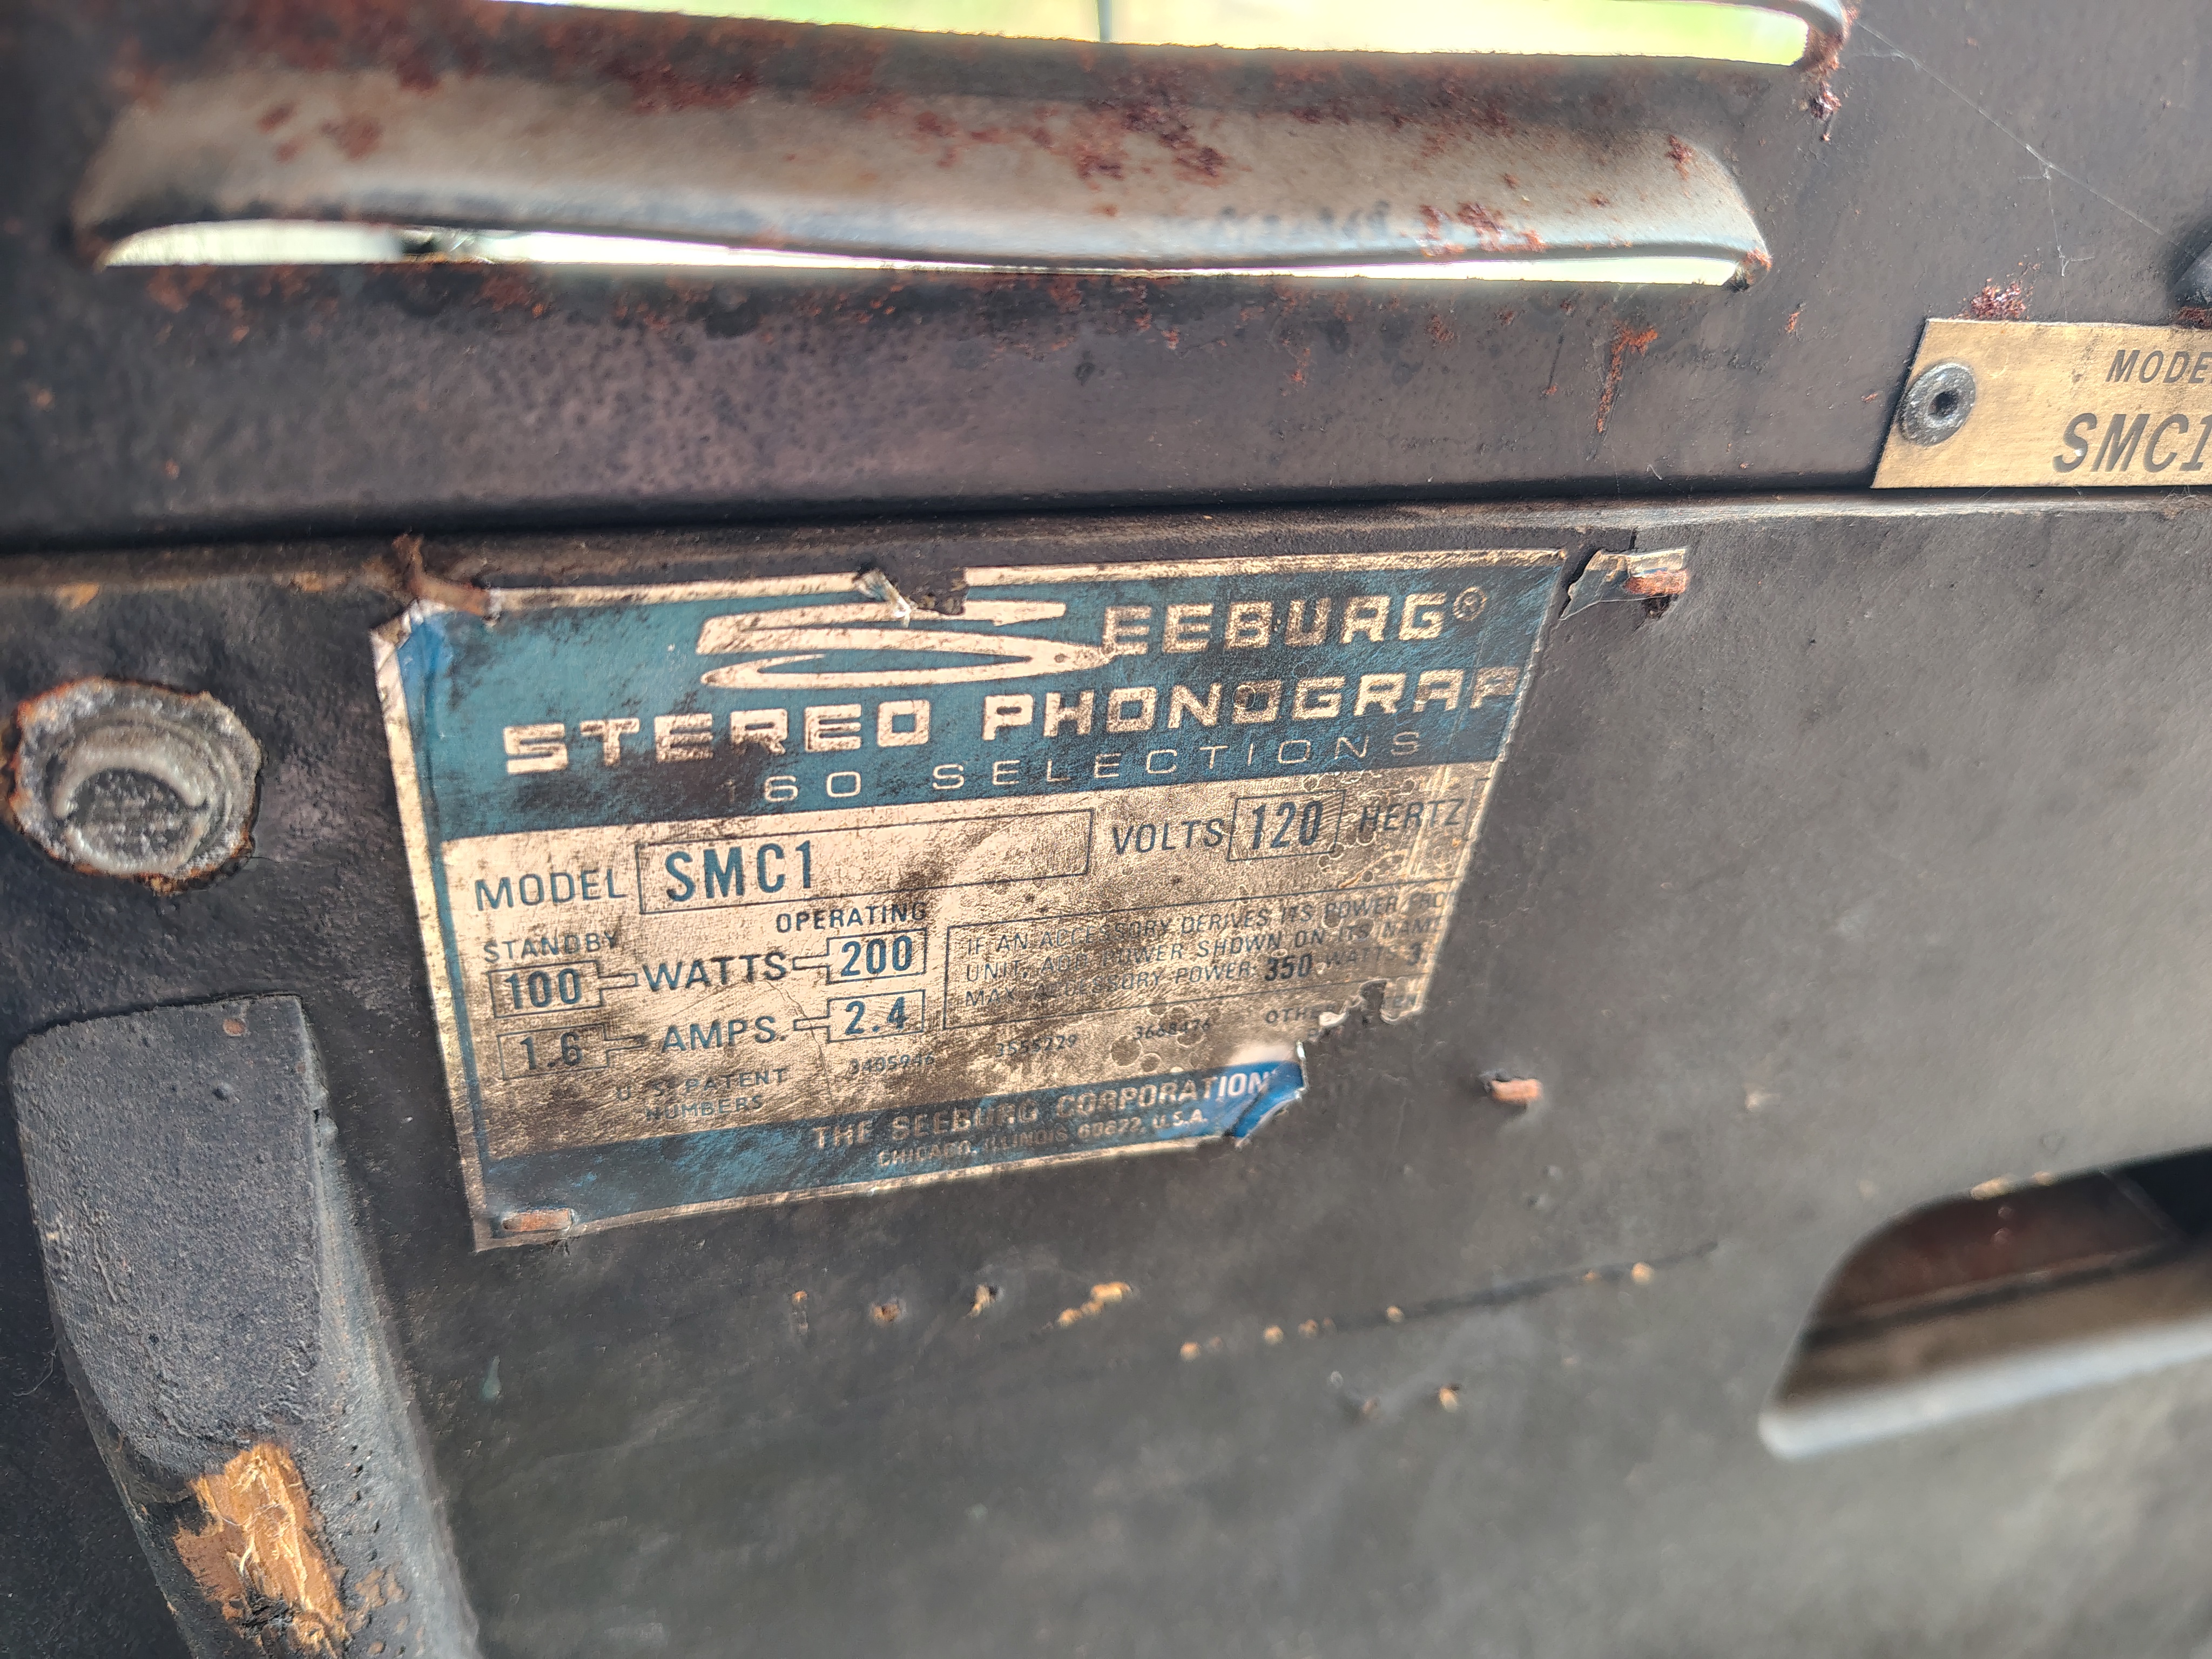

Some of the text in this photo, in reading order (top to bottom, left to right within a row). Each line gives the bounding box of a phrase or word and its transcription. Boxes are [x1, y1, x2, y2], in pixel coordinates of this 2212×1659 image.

[2106, 349, 2212, 383] MODE
[2052, 413, 2212, 473] SMC1
[503, 700, 931, 774] STEREO
[932, 731, 1420, 790] SELECTIONS
[475, 798, 1464, 911] MODEL SMC1 VOLTS 120 HERTZ
[777, 902, 927, 933] OPERATING
[968, 937, 984, 955] IF
[996, 933, 1027, 952] AN
[1039, 918, 1171, 948] ACCESSORY
[1181, 908, 1268, 934] DERIVES
[484, 931, 618, 963] STANDBY
[1102, 943, 1183, 967] POWER
[1197, 931, 1281, 958] SHOWN
[1296, 929, 1324, 949] ON
[1176, 961, 1250, 984] POWER
[1265, 953, 1313, 982] 350
[508, 935, 914, 1010] 100 WATTS 200
[521, 997, 907, 1070] 1.6 AMPS. 2.4
[685, 1068, 786, 1095] PATENT
[646, 1095, 763, 1122] NUMBERS
[812, 1071, 1270, 1149] THE SEEBURG CORPORATION
